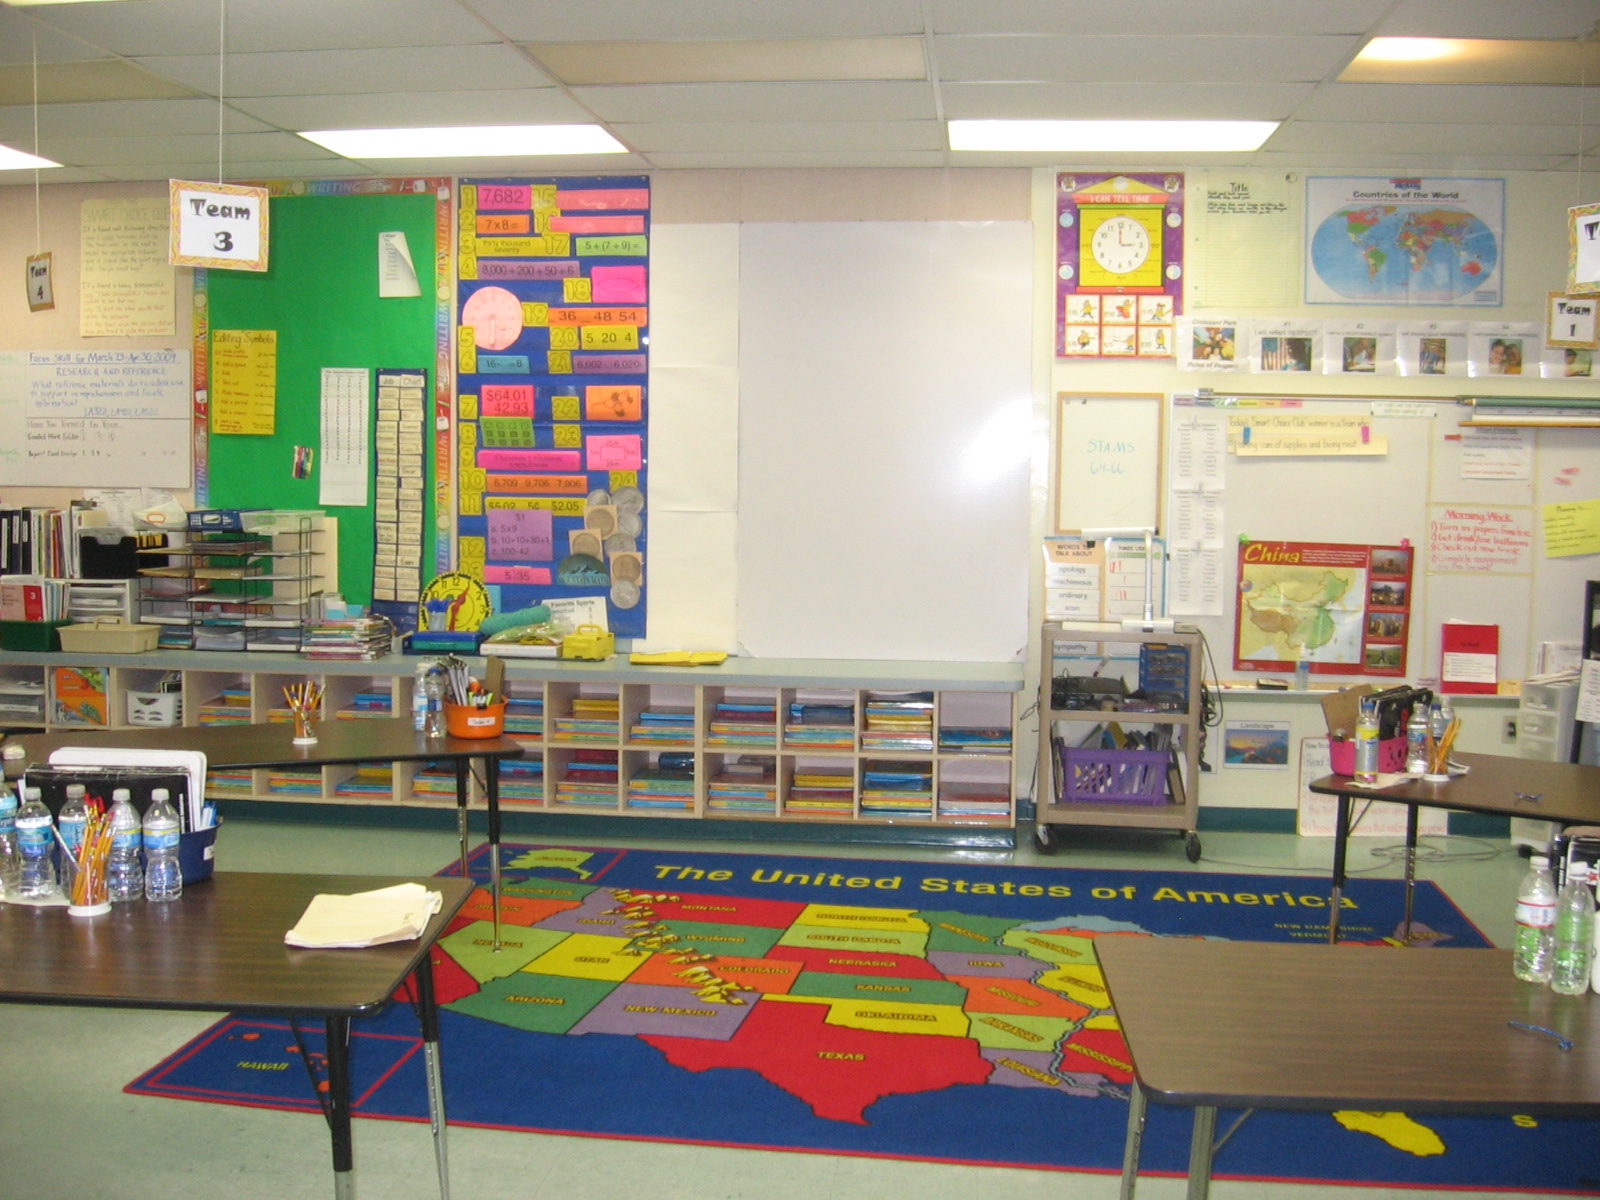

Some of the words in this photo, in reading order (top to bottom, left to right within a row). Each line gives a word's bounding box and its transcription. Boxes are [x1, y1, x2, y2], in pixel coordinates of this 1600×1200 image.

[307, 180, 360, 193] WRITING
[462, 187, 474, 207] 1
[482, 188, 524, 205] 7,682
[1095, 195, 1111, 203] CAN
[1114, 195, 1130, 203] TELL
[1132, 195, 1150, 203] TIME
[1353, 191, 1399, 199] Countries
[1401, 191, 1411, 199] of
[1413, 191, 1428, 199] the
[1431, 191, 1459, 200] World
[190, 199, 250, 220] Team
[460, 212, 475, 231] 2
[1584, 221, 1600, 240] T
[213, 231, 234, 251] 3
[460, 235, 475, 254] 3
[483, 239, 499, 248] thirty
[500, 239, 531, 247] thousand
[543, 235, 568, 254] 17
[30, 266, 47, 278] Team
[461, 257, 476, 277] 4
[37, 286, 43, 300] 4
[564, 279, 590, 300] 18
[523, 303, 547, 323] 19
[1557, 302, 1591, 316] Team
[558, 311, 576, 321] 36
[593, 311, 612, 321] 48
[619, 311, 636, 321] 54
[438, 304, 449, 360] WRITING
[1569, 323, 1576, 337] 1
[214, 332, 241, 349] Editing
[244, 331, 274, 346] Symbols
[460, 328, 474, 347] 5
[552, 328, 574, 347] 20
[586, 333, 593, 343] 5
[602, 333, 616, 342] 20
[624, 333, 632, 342] 4
[29, 352, 49, 362] Focus
[76, 353, 85, 363] for
[88, 352, 113, 363] March
[154, 352, 177, 362] 2009
[460, 352, 473, 371] 6
[549, 353, 571, 373] 21
[56, 367, 99, 376] RESEARCH
[103, 367, 120, 376] AND
[122, 367, 166, 376] REFERENCE
[32, 380, 52, 389] What
[55, 380, 86, 388] reference
[90, 380, 125, 388] materials
[383, 377, 394, 385] Job
[403, 376, 421, 385] Chart
[40, 390, 67, 399] support
[486, 389, 527, 402] $64.01
[461, 397, 476, 416] 7
[494, 402, 529, 415] 42.93
[553, 398, 579, 418] 22
[461, 424, 475, 445] 8
[555, 426, 580, 446] 23
[1309, 440, 1321, 448] and
[1323, 439, 1340, 451] being
[460, 447, 474, 467] 9
[460, 470, 485, 490] 10
[461, 493, 481, 513] 11
[552, 501, 580, 511] $2.05
[1445, 509, 1485, 524] Morning
[1487, 511, 1513, 522] Work
[460, 538, 485, 558] 12
[1245, 543, 1300, 563] China
[1059, 566, 1086, 574] apology
[442, 580, 447, 589] 11
[453, 577, 460, 586] 12
[30, 592, 36, 600] 3
[476, 592, 481, 600] 2
[1059, 592, 1088, 600] ordinary
[480, 605, 485, 614] 3
[1054, 643, 1088, 652] sympathy
[1240, 722, 1275, 730] Landscape
[1306, 755, 1324, 766] Read
[655, 865, 734, 881] The
[751, 868, 903, 890] United
[920, 878, 1072, 898] States
[1091, 885, 1136, 900] of
[1153, 886, 1358, 909] America
[681, 904, 738, 912] MONTANA
[1275, 922, 1301, 930] NEW
[685, 934, 746, 943] WYOMING
[807, 934, 849, 942] SOUTH
[851, 936, 901, 945] DAKOTA
[574, 956, 611, 964] UTAH
[828, 958, 897, 968] NEBRASKA
[968, 960, 1004, 968] IOWA
[719, 965, 791, 974] COLORADO
[855, 984, 912, 993] KANSAS
[504, 995, 566, 1005] ARIZONA
[624, 1004, 658, 1014] NEW
[662, 1006, 718, 1017] MEXICO
[855, 1011, 937, 1022] OKLAHOMA
[817, 1052, 866, 1062] TEXAS
[237, 1060, 291, 1071] HAWAII
